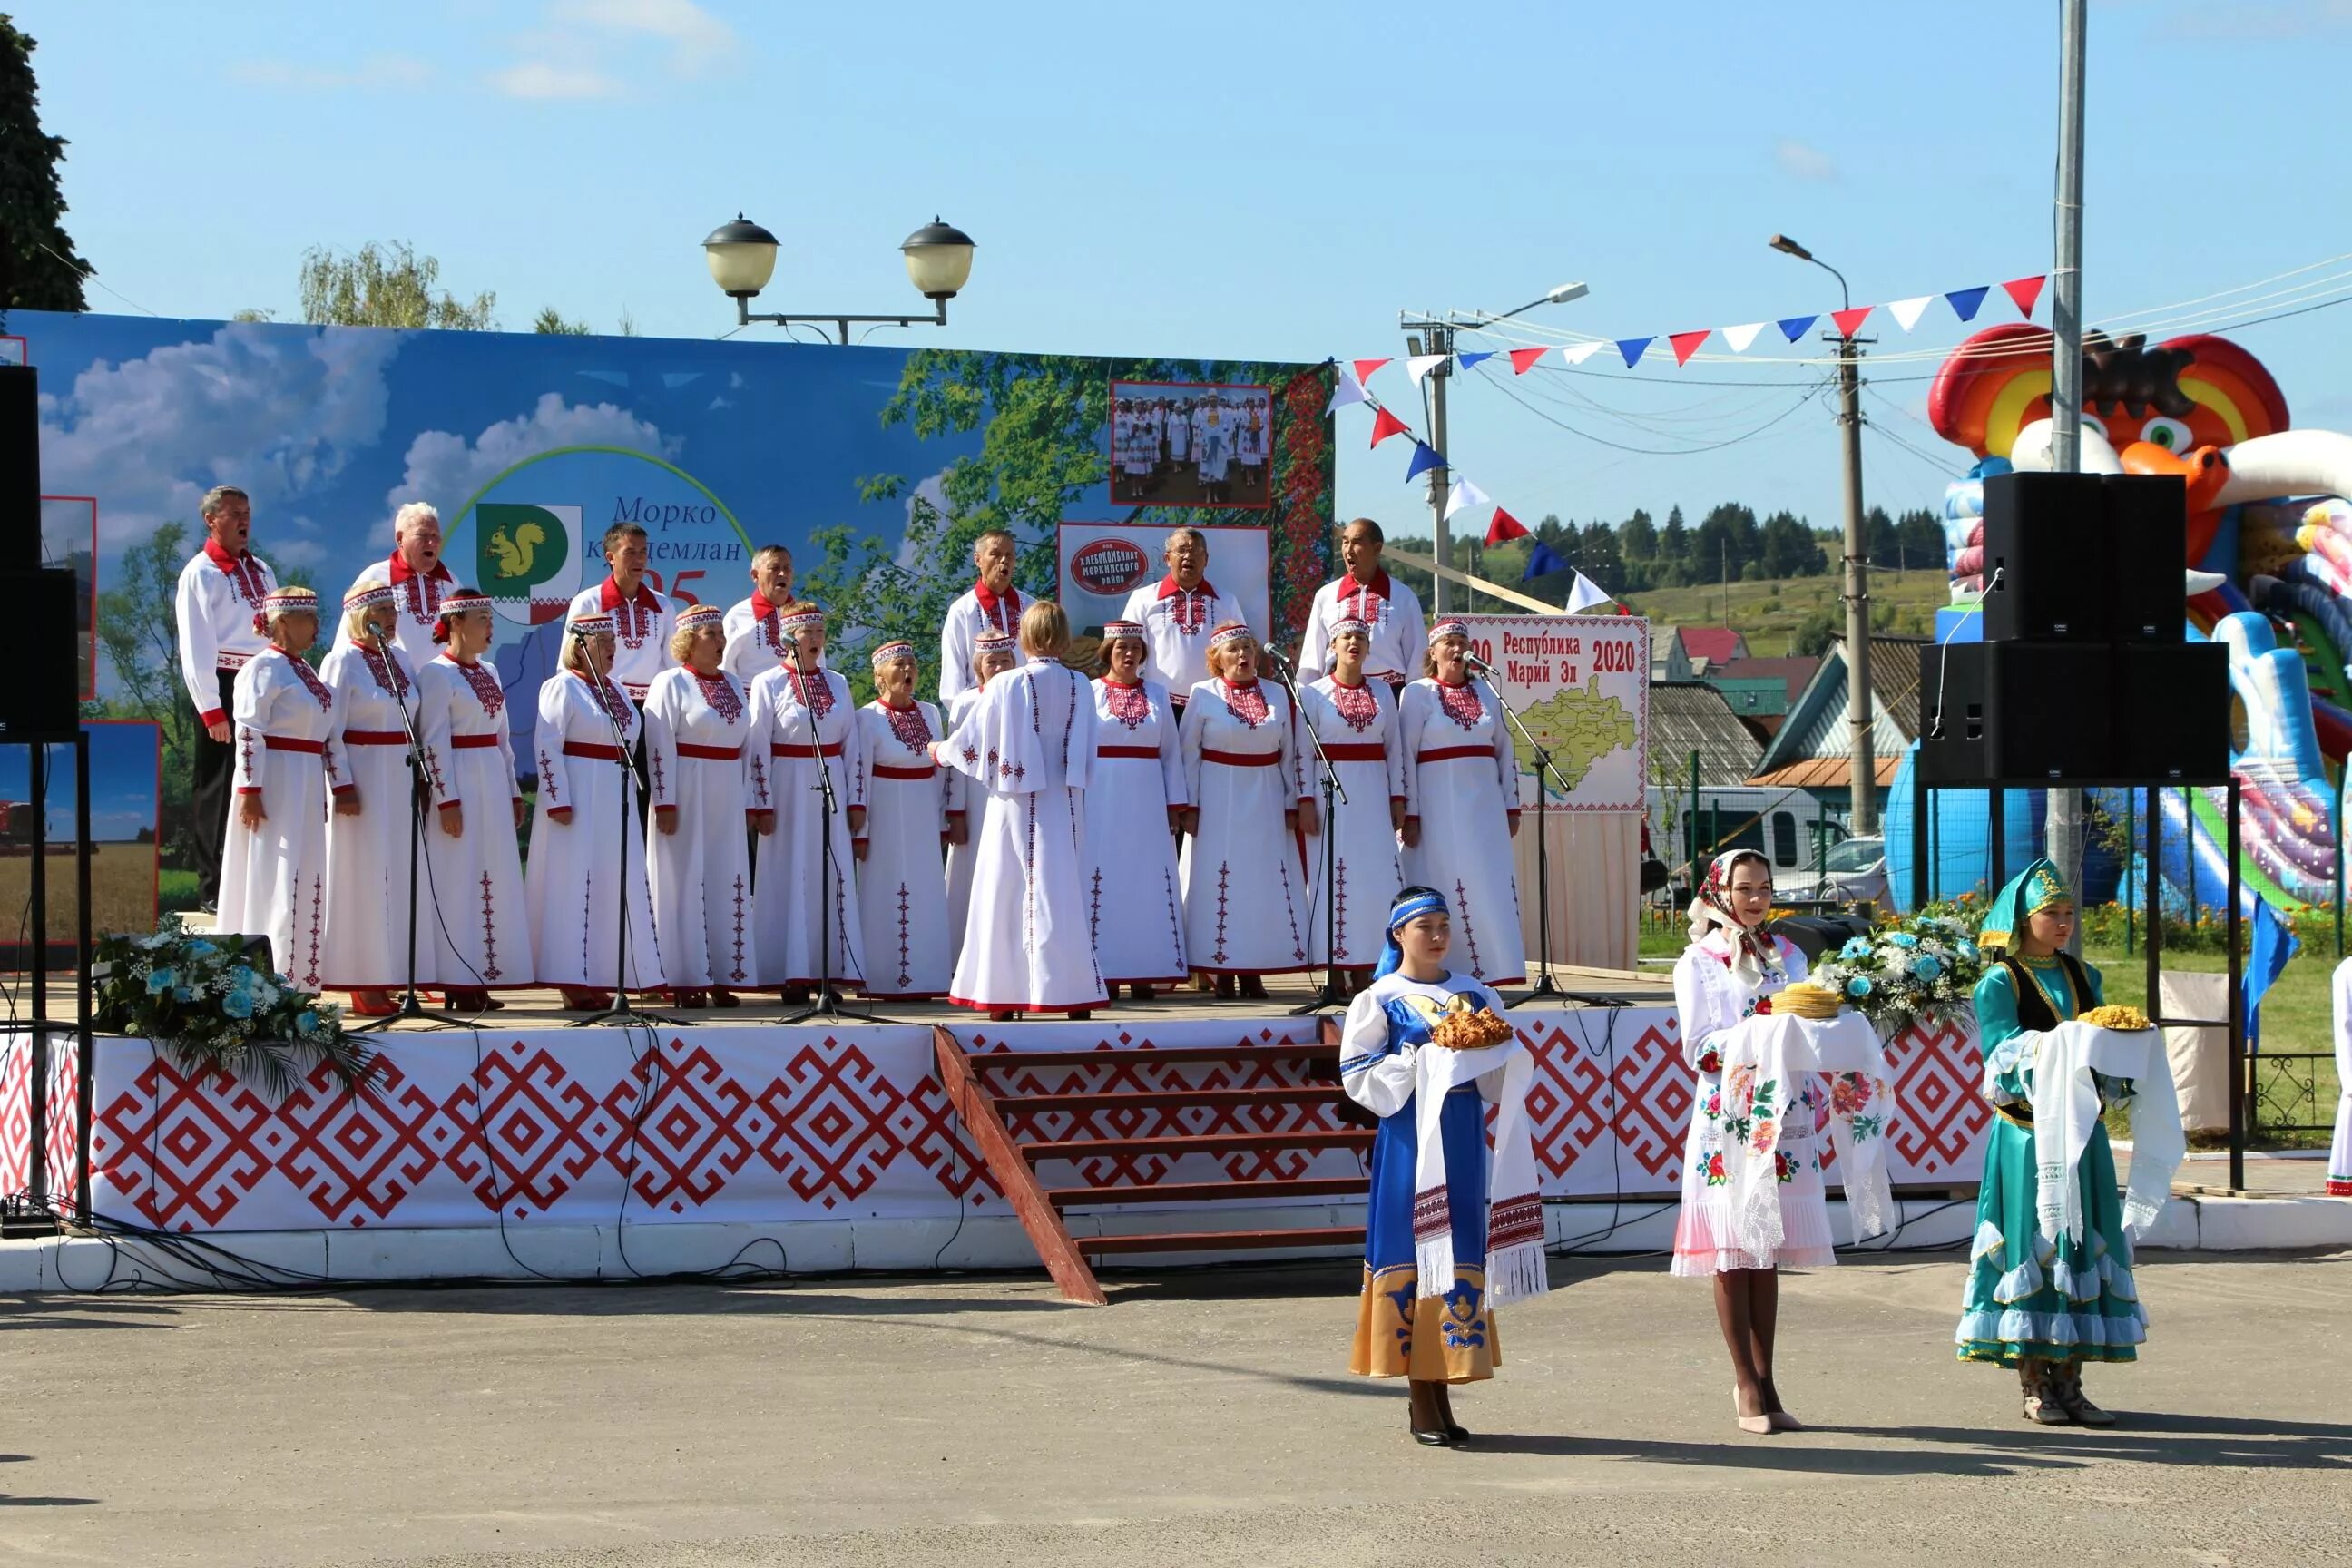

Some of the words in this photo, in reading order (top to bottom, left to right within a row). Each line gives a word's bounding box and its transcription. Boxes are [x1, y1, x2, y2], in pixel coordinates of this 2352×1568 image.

[612, 496, 716, 531] Морко
[586, 540, 742, 567] кемлан
[1079, 551, 1139, 566] ХЛЕБОКОМБИНАТ
[1082, 562, 1140, 576] МОРКИНСКОГО
[1503, 630, 1581, 662] Республика
[1592, 639, 1635, 673] 2020
[1507, 660, 1551, 689] Марий
[1560, 660, 1578, 683] Эл
